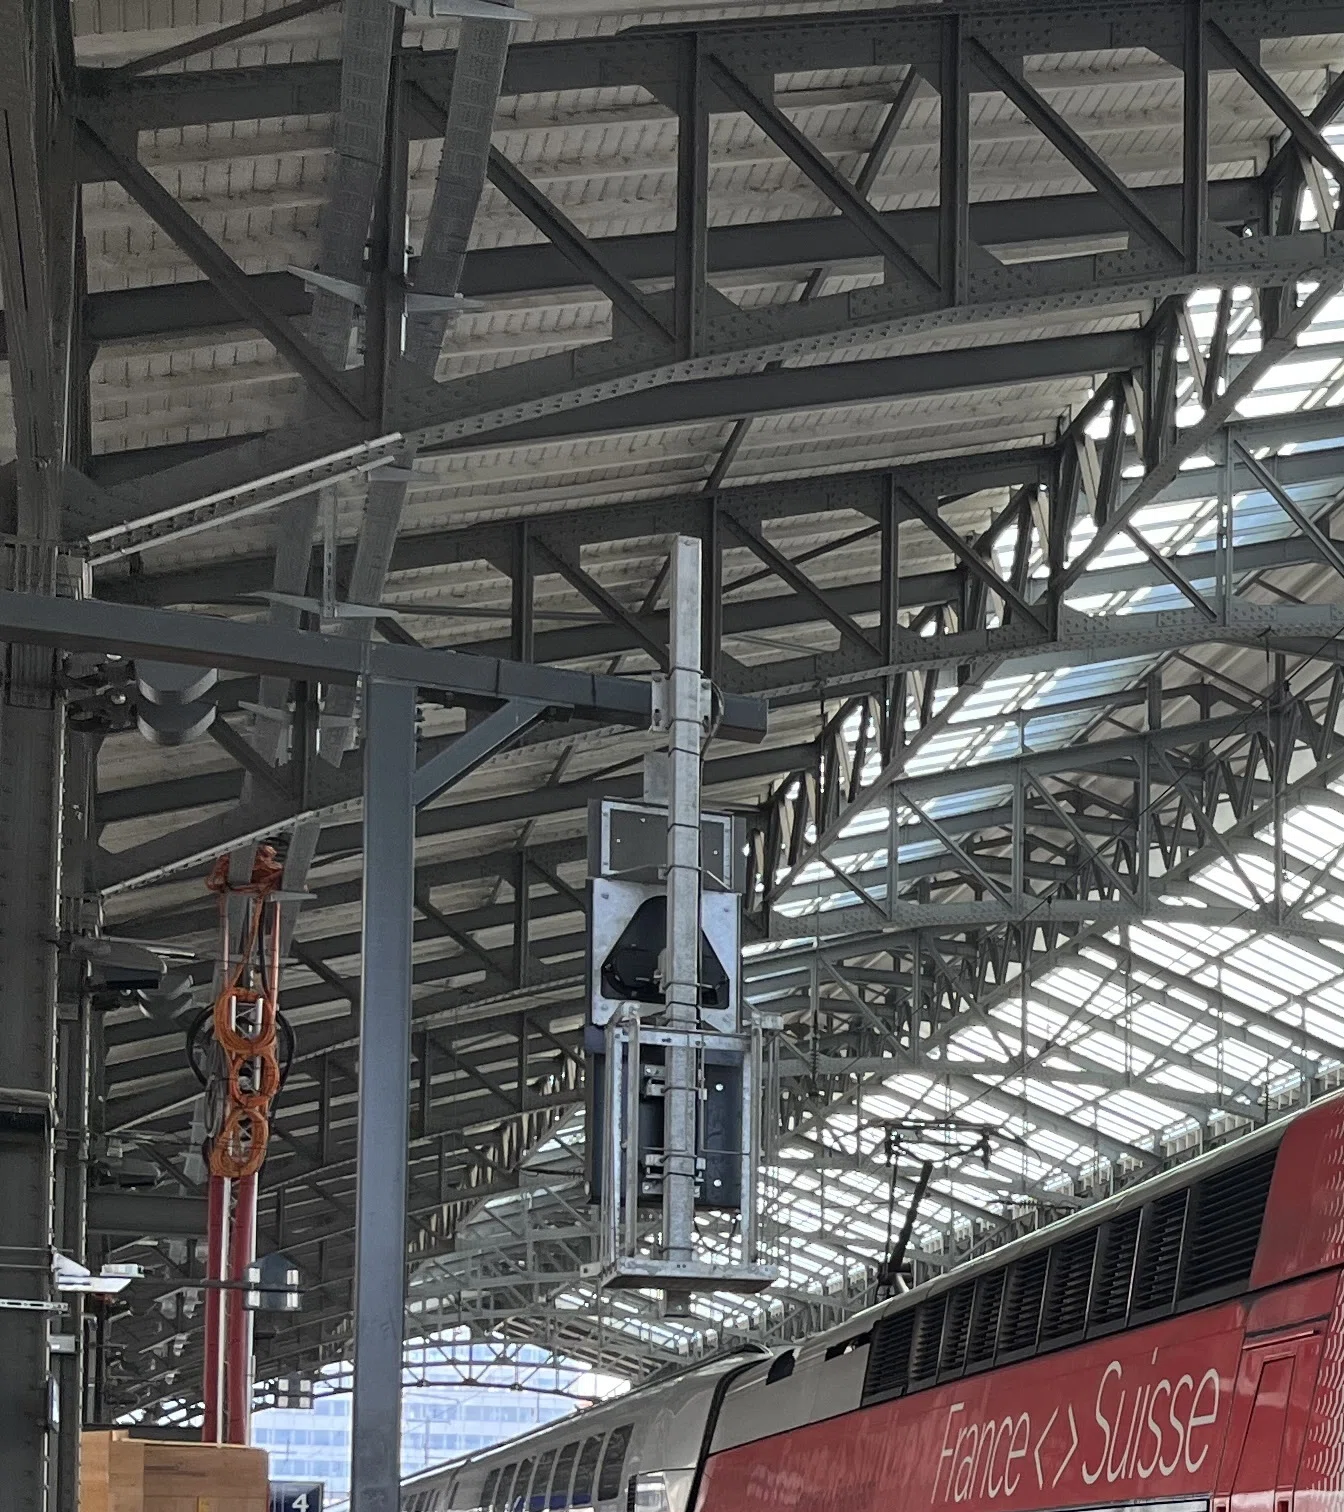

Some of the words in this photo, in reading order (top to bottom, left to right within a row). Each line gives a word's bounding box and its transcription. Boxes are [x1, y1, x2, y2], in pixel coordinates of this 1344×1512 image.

[930, 1401, 1030, 1504] France
[1082, 1346, 1221, 1485] Suisse
[292, 1493, 309, 1512] 4
